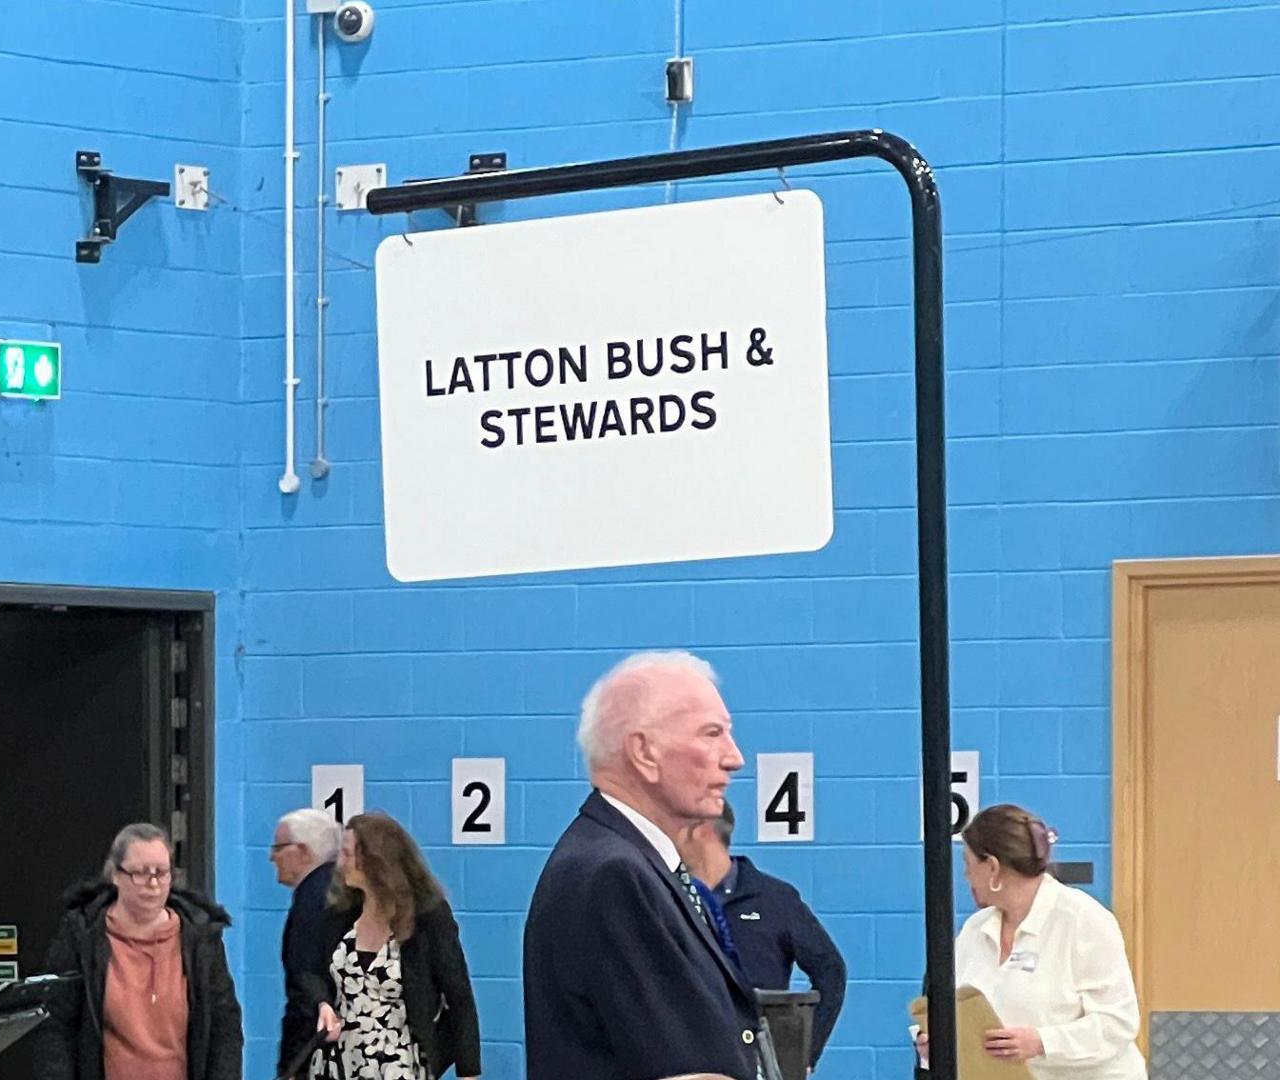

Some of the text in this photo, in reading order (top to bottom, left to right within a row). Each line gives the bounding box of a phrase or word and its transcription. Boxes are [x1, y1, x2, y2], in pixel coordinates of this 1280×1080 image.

[425, 327, 775, 396] LATTON BUSH &
[480, 391, 718, 449] STEWARDS
[324, 787, 344, 825] 1
[461, 781, 491, 833] 2
[765, 771, 806, 835] 4
[950, 772, 970, 836] 5
